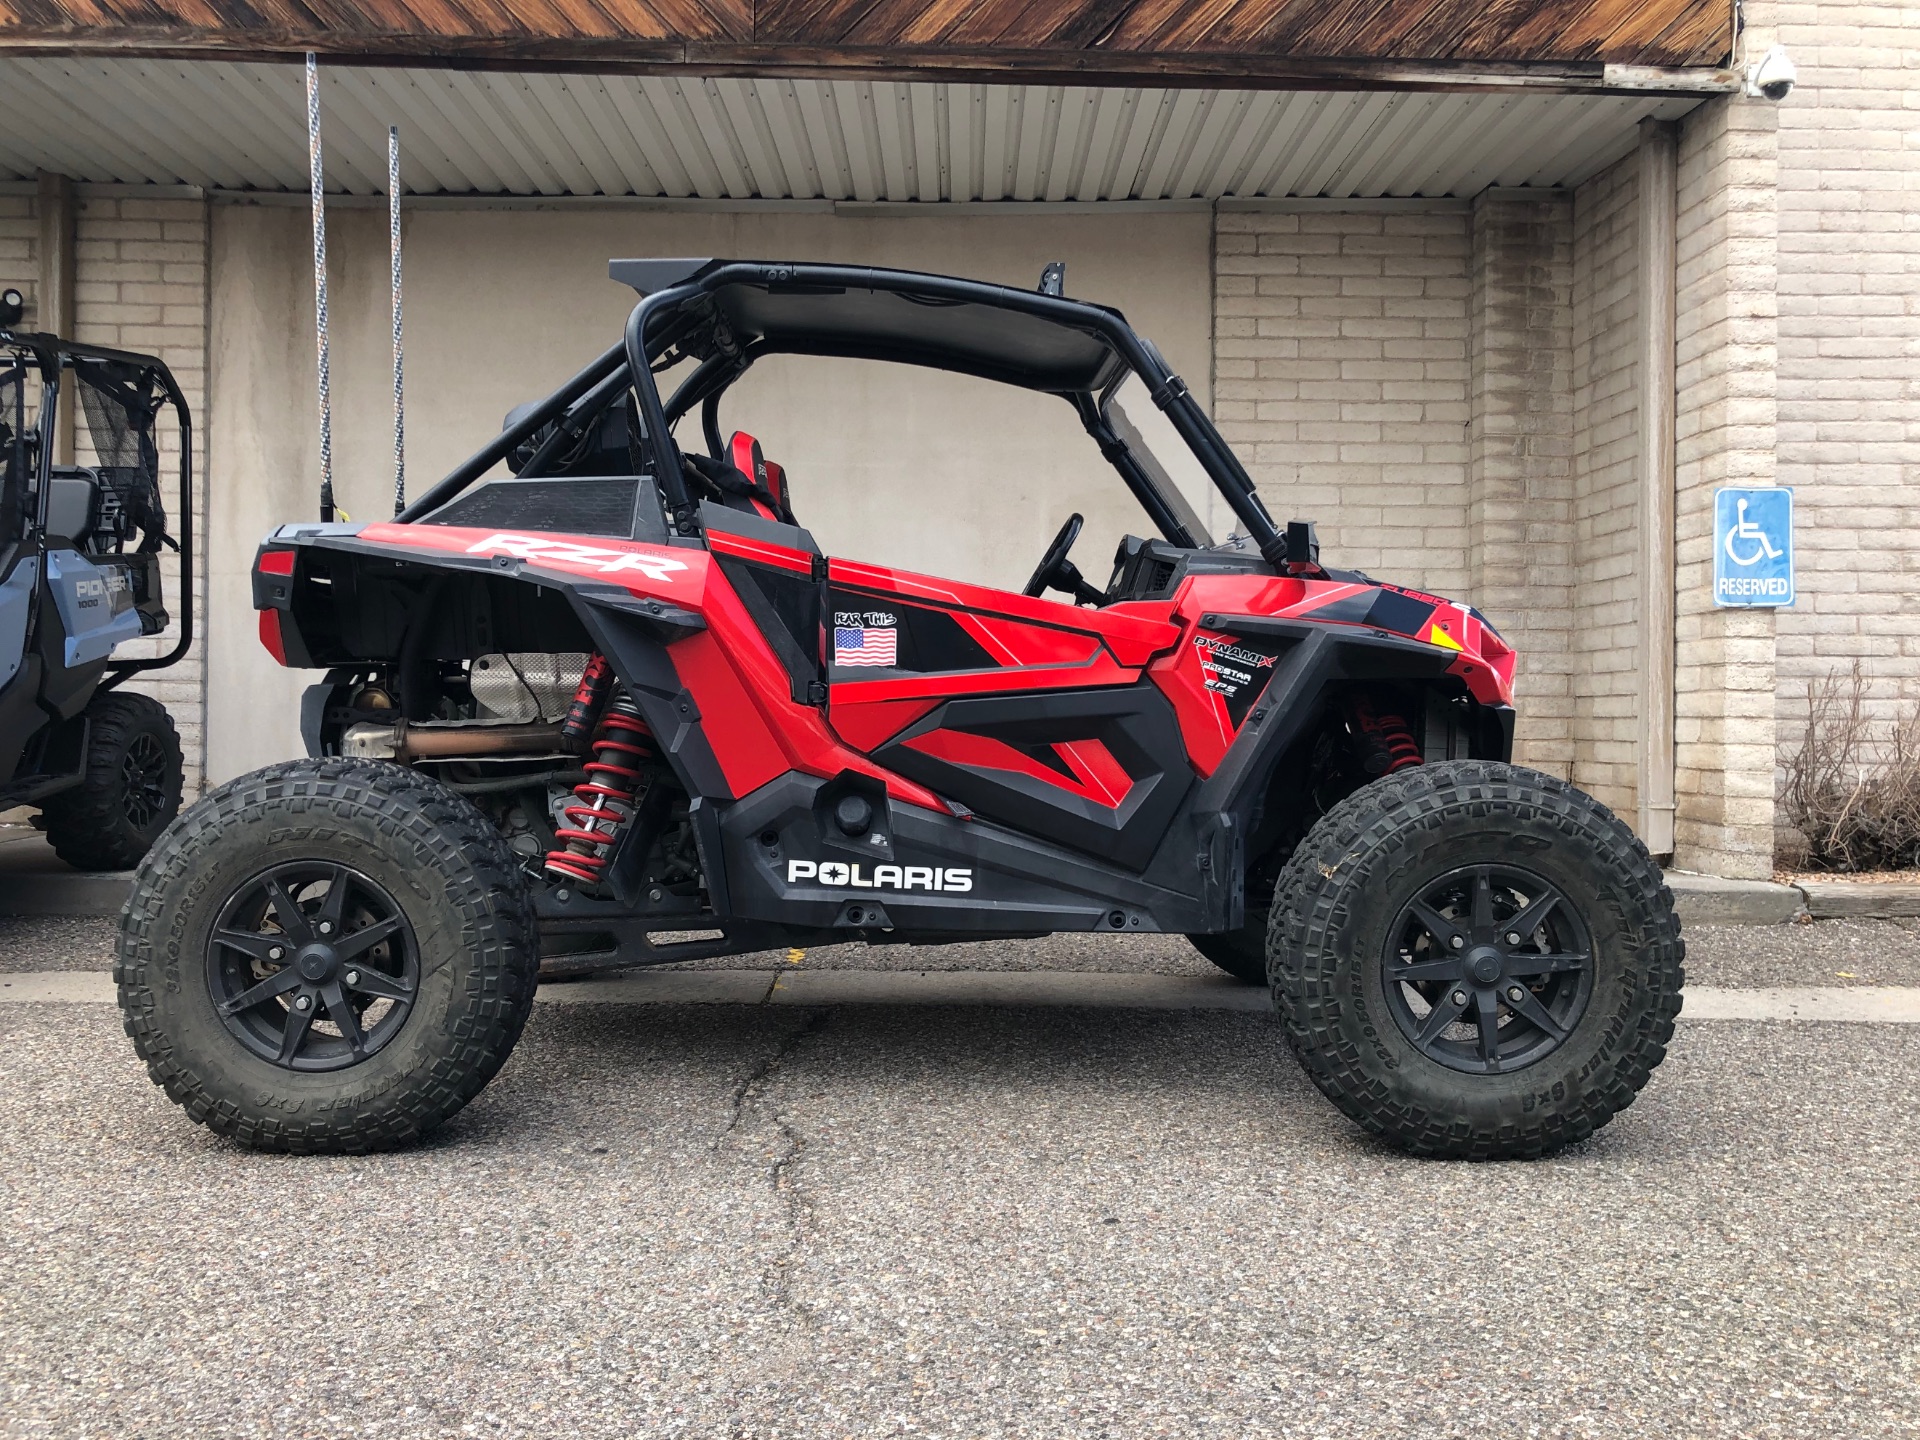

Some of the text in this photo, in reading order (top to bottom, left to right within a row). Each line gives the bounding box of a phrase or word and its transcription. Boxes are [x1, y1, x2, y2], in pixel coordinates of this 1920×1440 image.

[465, 533, 689, 583] RZR
[618, 545, 673, 559] POLARIS
[1719, 577, 1788, 596] RESERVED
[78, 599, 99, 609] 1000
[834, 611, 864, 628] FEAR
[1193, 635, 1279, 668] DYNAMIX
[1202, 661, 1252, 682] PROSTAR
[1204, 679, 1238, 693] EPS
[787, 859, 973, 892] POLARIS
